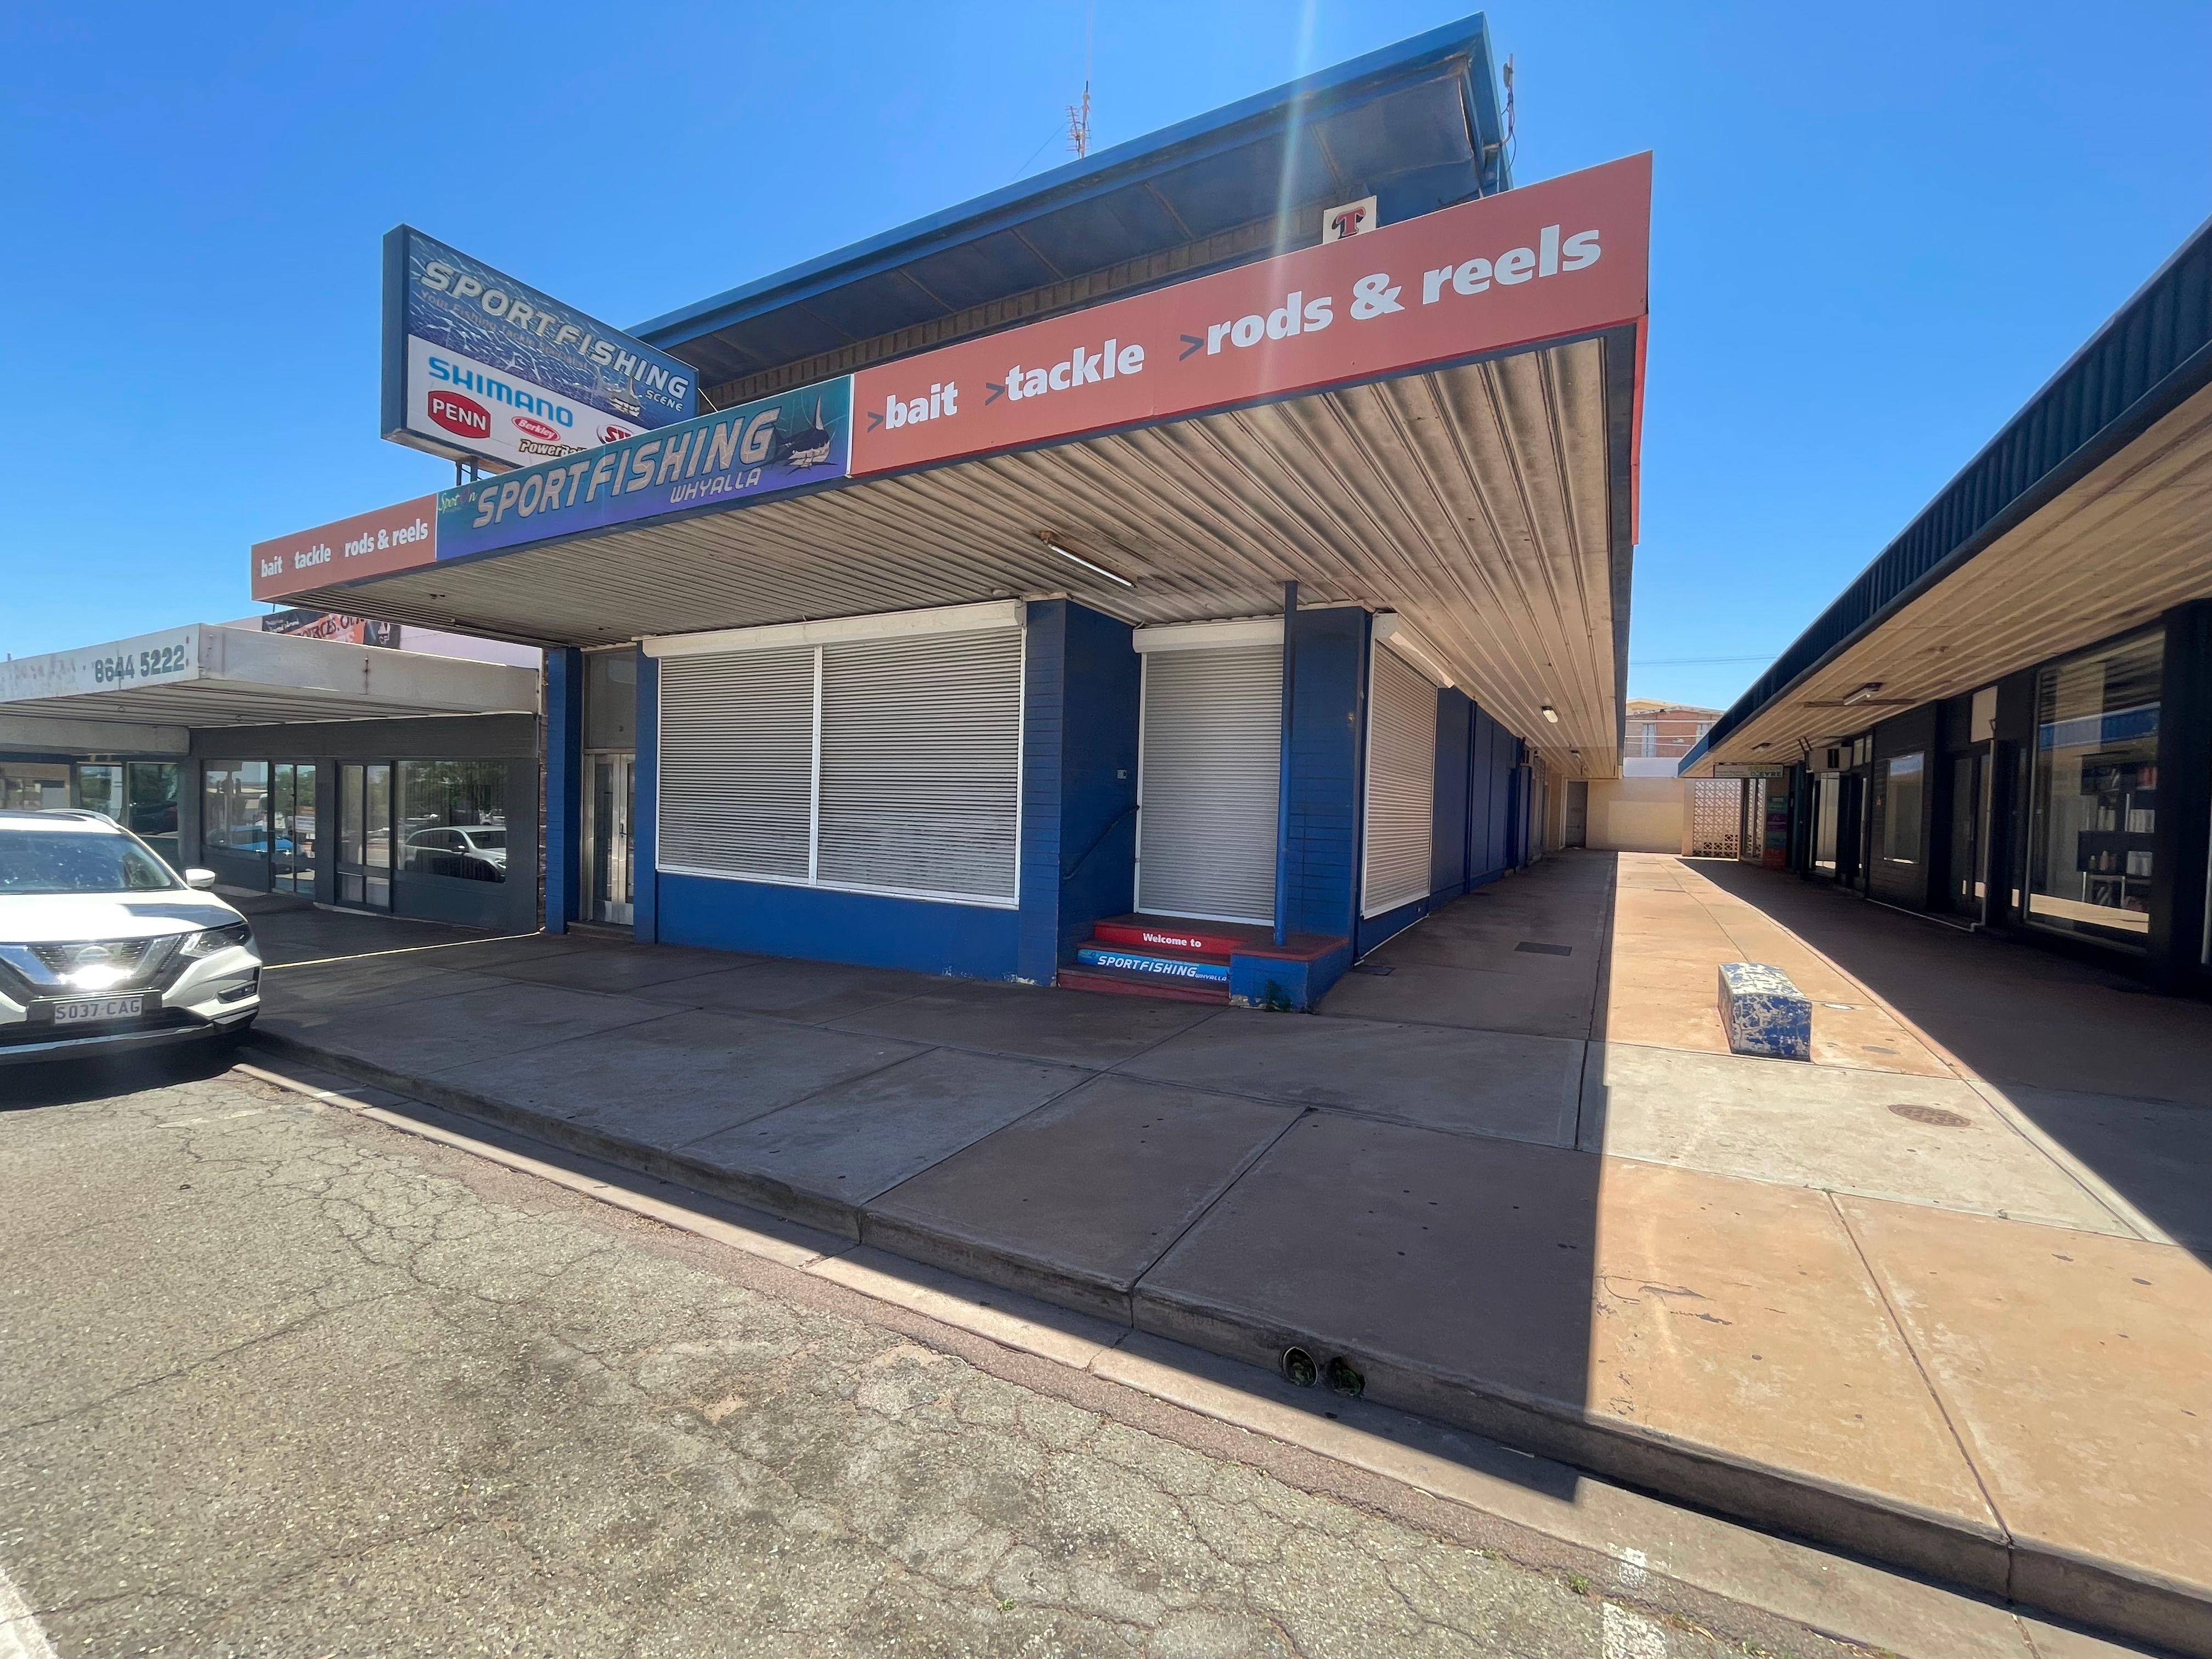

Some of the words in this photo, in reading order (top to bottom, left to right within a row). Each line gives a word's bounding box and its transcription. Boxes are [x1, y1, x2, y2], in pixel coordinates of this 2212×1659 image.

[1331, 206, 1366, 239] T
[420, 260, 689, 400] SPORTFISHING
[885, 381, 958, 430] bait
[1005, 338, 1144, 401] tackle
[1207, 291, 1334, 356] rods
[1350, 273, 1406, 320] &
[1423, 224, 1601, 305] reels
[428, 357, 573, 427] SHIMANO
[646, 390, 684, 412] SCENE
[432, 398, 486, 431] PENN
[517, 419, 556, 439] Berkley
[471, 407, 782, 529] SPORTFISHING
[669, 467, 761, 504] WHYALLA
[261, 555, 283, 578] bait
[295, 543, 331, 569] tackle
[345, 532, 375, 558] rods
[377, 529, 390, 550] &
[392, 518, 428, 546] reels
[95, 654, 134, 683] 8644
[139, 645, 185, 677] 5222
[1143, 933, 1187, 946] Welcome
[1190, 938, 1201, 947] to
[1097, 956, 1198, 978] SPORTFISHING
[1195, 973, 1227, 981] WHYALLA
[55, 1003, 99, 1020] S037
[106, 1000, 140, 1015] CAG
